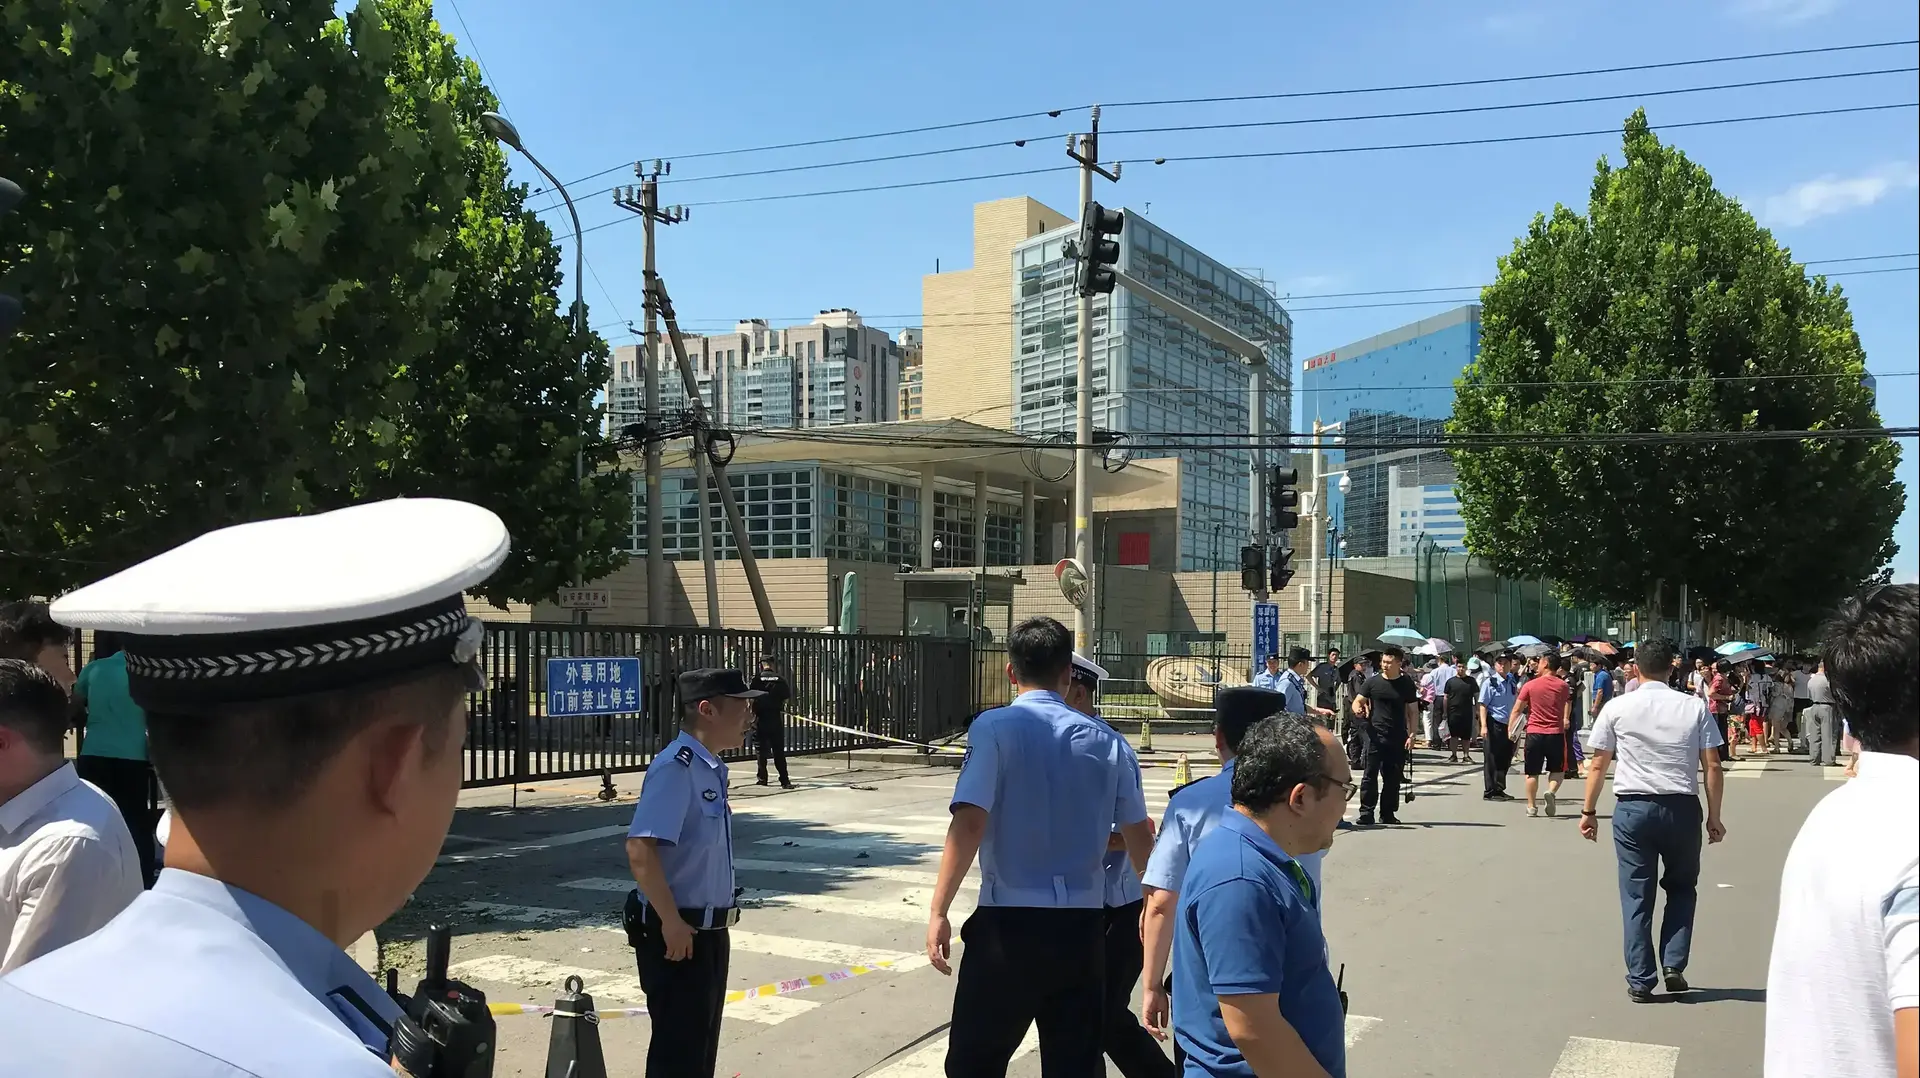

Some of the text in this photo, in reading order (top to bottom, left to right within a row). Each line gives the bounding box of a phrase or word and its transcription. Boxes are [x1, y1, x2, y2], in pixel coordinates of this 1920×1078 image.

[566, 661, 621, 685] 外事用地
[553, 687, 636, 712] 门前禁止停车
